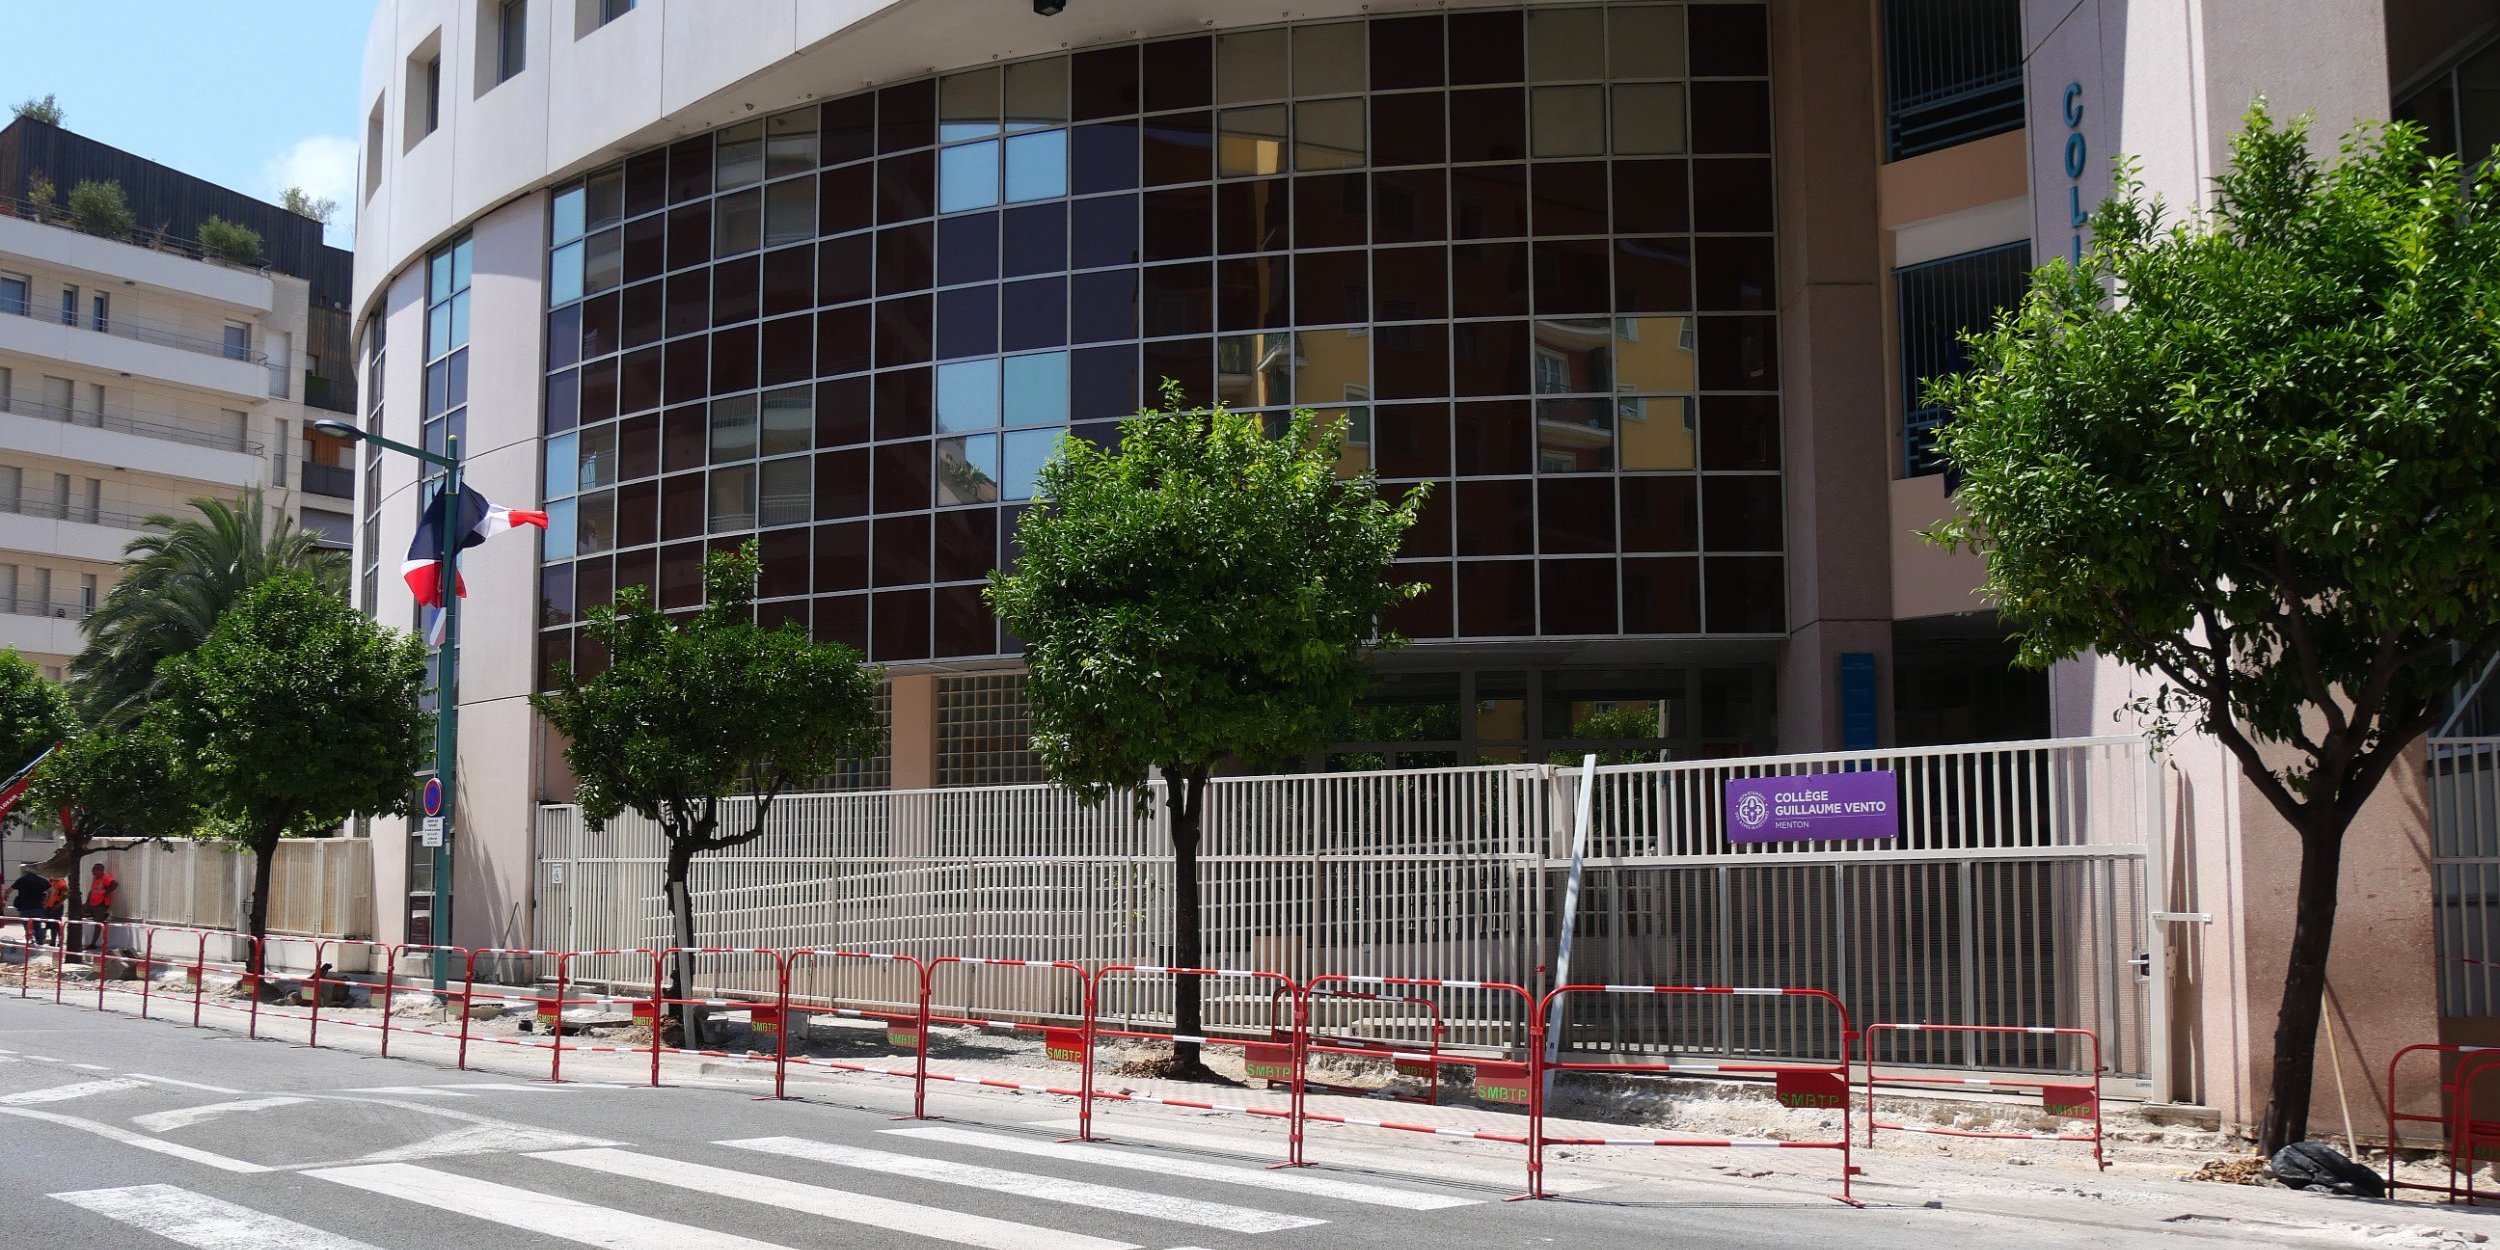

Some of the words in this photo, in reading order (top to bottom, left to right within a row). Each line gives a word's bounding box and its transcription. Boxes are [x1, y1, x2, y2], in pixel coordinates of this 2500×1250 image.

[1775, 789, 1829, 803] COLLÈGE
[1775, 803, 1842, 816] GUILLAUME
[1844, 801, 1886, 813] VENTO
[1775, 820, 1810, 829] MENTON
[751, 1022, 777, 1033] SMBTP
[1047, 1047, 1082, 1062] SMBTP
[1247, 1064, 1291, 1078] SMBTP
[1396, 1064, 1431, 1077] SMBTP
[1478, 1085, 1528, 1102] SMBTP
[1779, 1092, 1840, 1107] SMBTP
[2043, 1104, 2091, 1116] SMBTP
